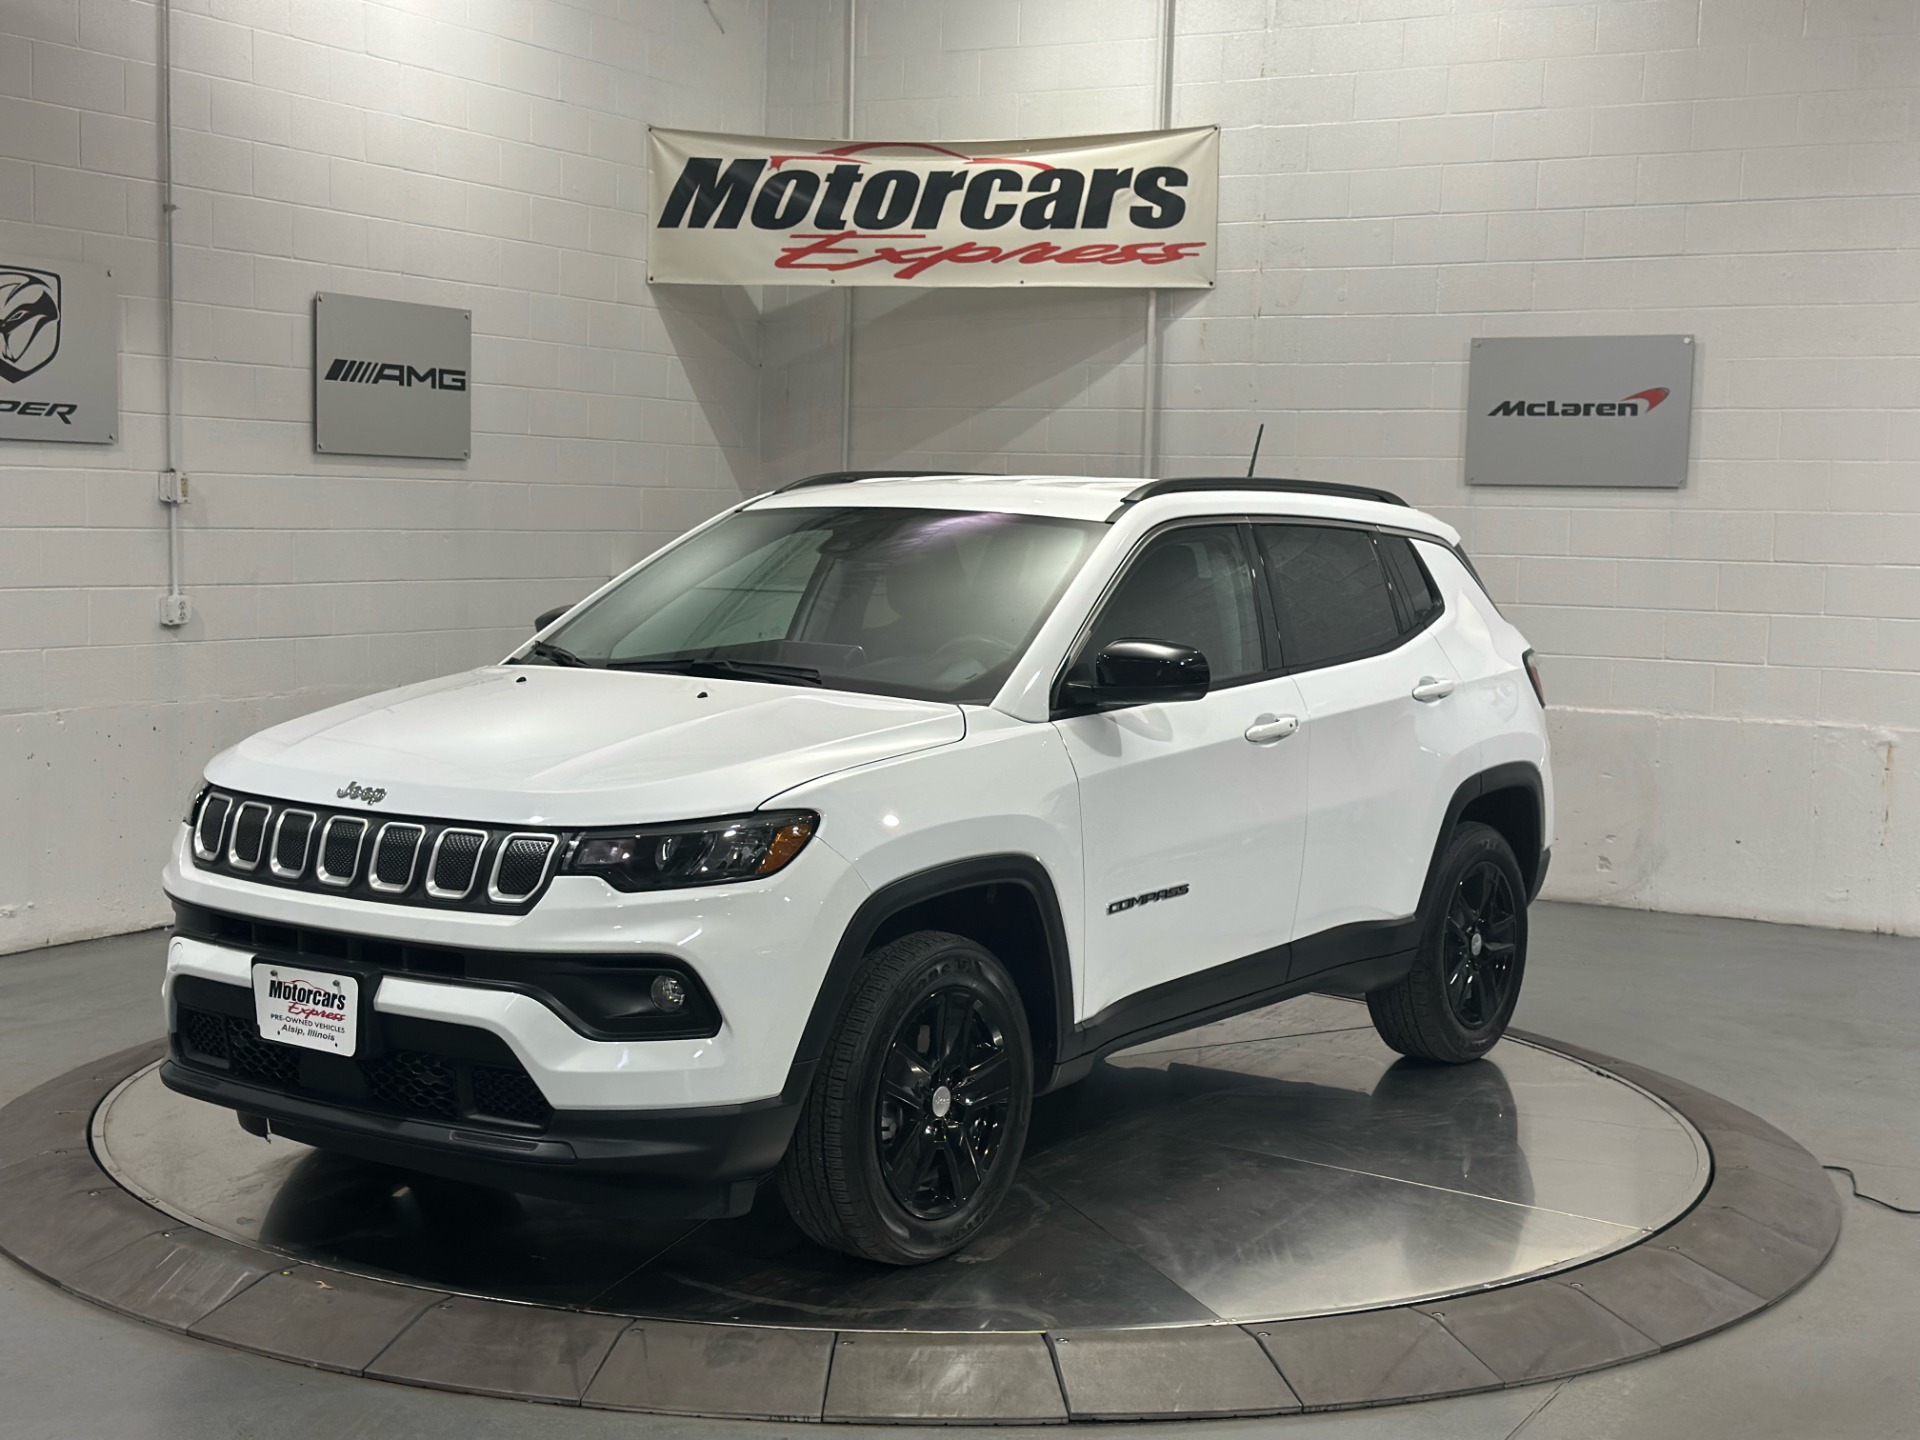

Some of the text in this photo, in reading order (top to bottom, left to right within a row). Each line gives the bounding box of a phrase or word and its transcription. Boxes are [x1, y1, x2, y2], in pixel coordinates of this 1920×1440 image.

[657, 157, 1189, 230] Motorcars
[774, 230, 1207, 279] Express
[1487, 400, 1639, 417] McLaren
[336, 780, 387, 806] Jeep
[1106, 883, 1190, 916] COMPASS
[268, 980, 346, 1011] Motorcars
[270, 1013, 345, 1034] PRE-OWNED VEHICLES
[287, 1001, 346, 1022] Express
[281, 1024, 335, 1041] Alsip, Illinois
